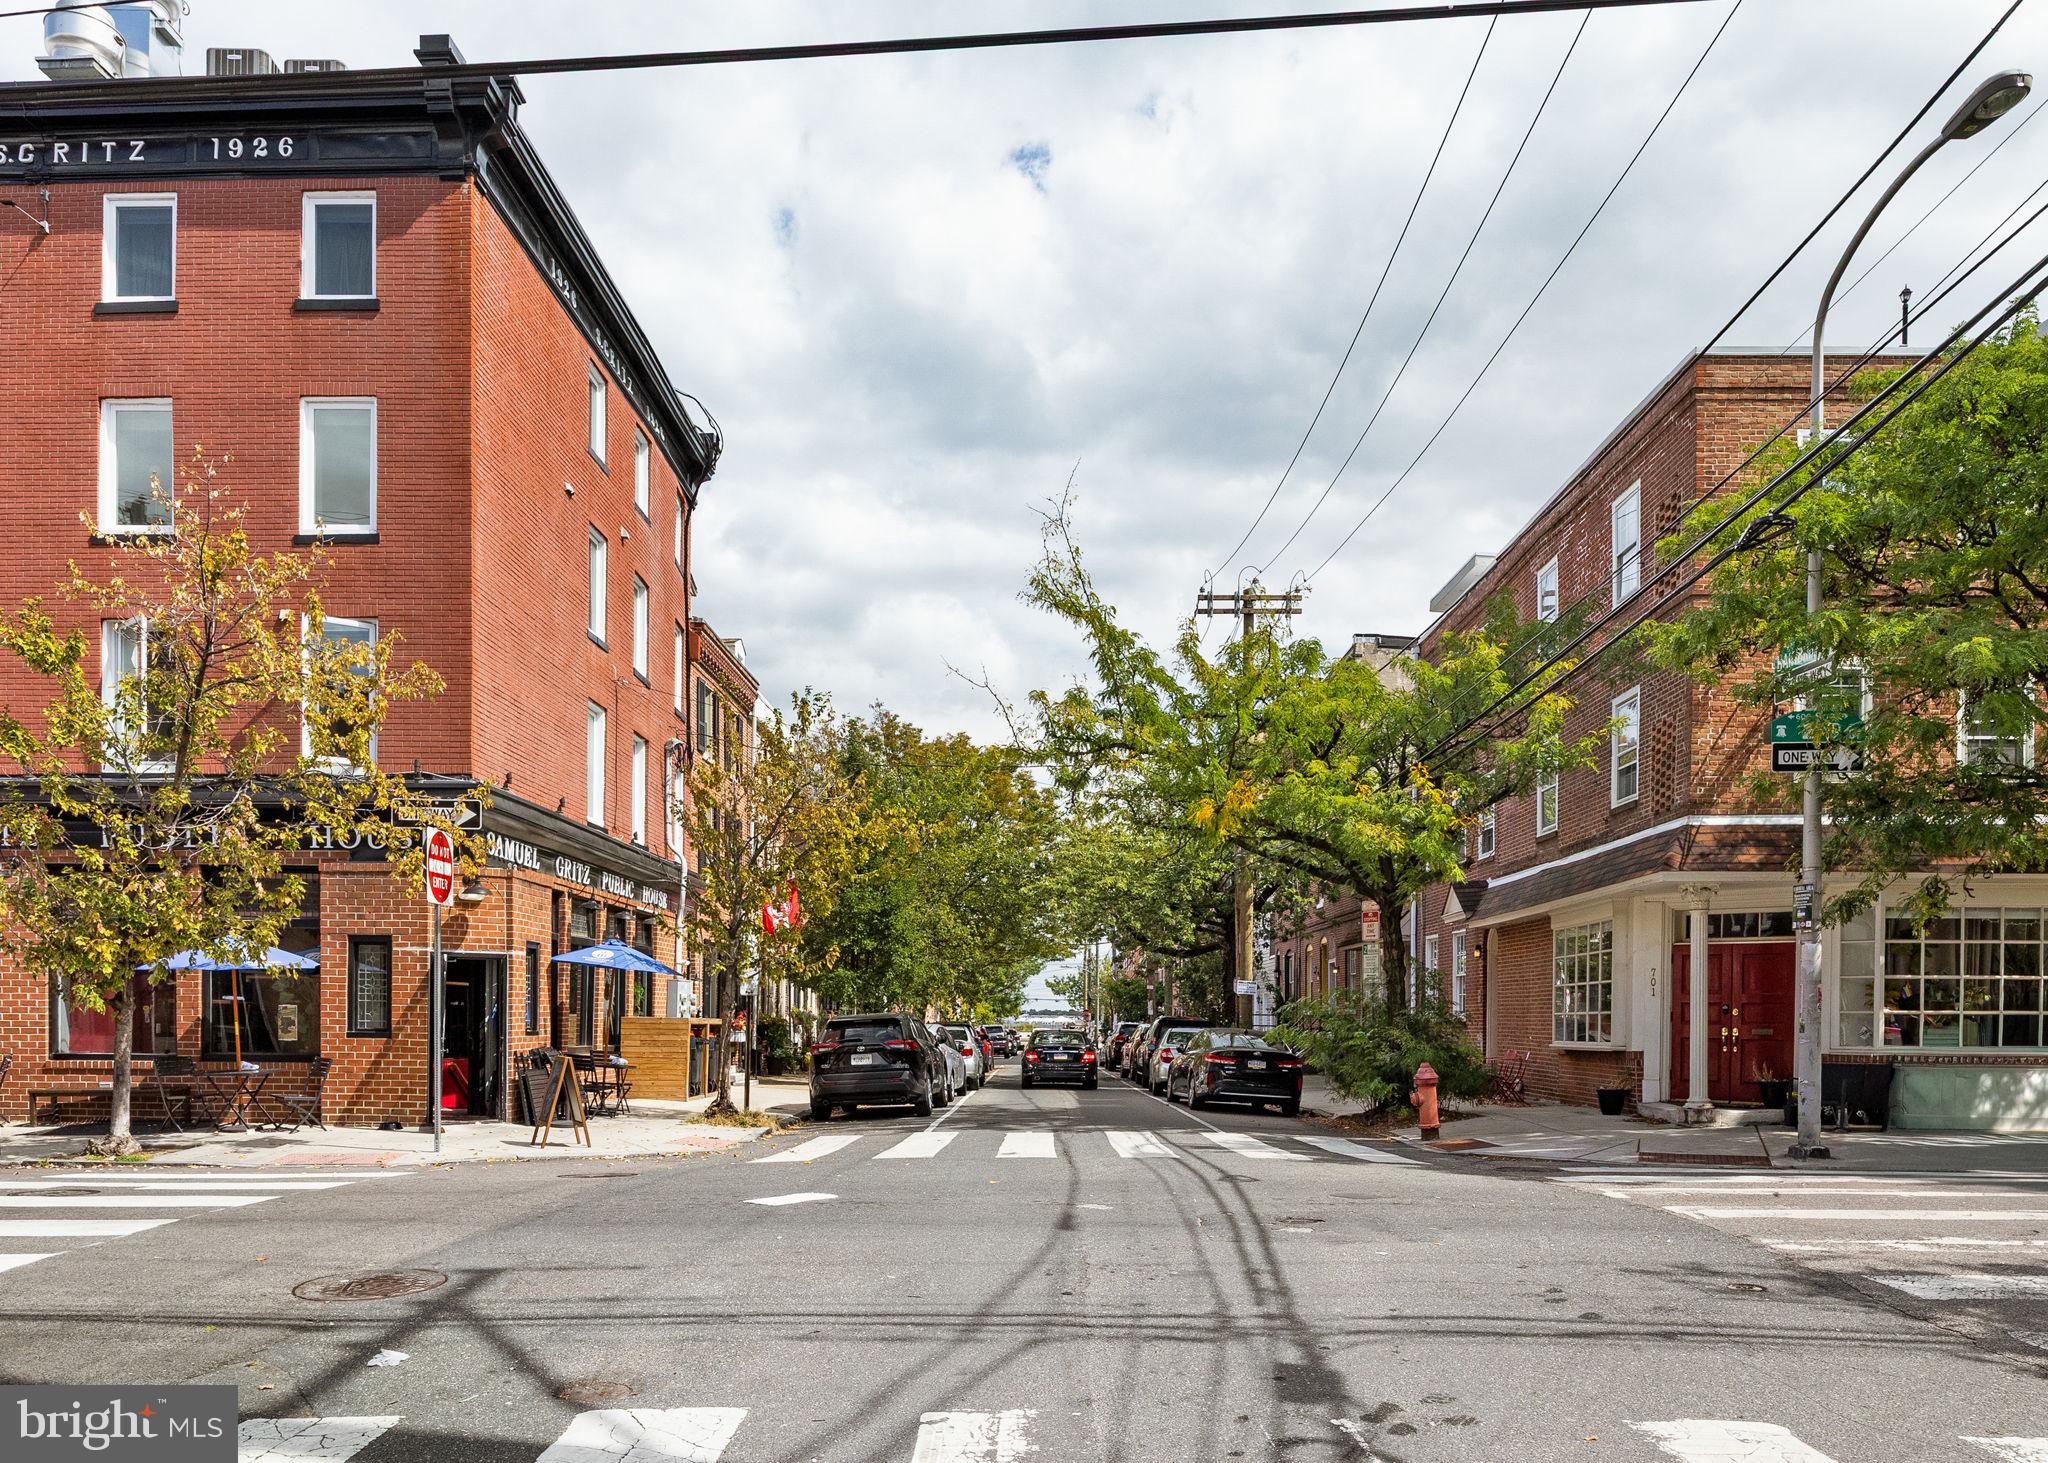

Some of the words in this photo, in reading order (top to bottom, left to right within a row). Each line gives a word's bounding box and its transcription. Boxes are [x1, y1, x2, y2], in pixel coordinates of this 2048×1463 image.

[211, 136, 293, 159] 1926
[1783, 752, 1807, 763] ONE
[1812, 752, 1836, 763] WY
[309, 823, 426, 849] HOU
[431, 843, 439, 856] DO
[439, 846, 450, 859] NOT
[487, 832, 540, 870] SAMUEL
[556, 856, 590, 885] GRITZ
[602, 872, 635, 898] PUBLIC
[643, 886, 668, 909] HOUSE
[432, 876, 448, 890] ENTER
